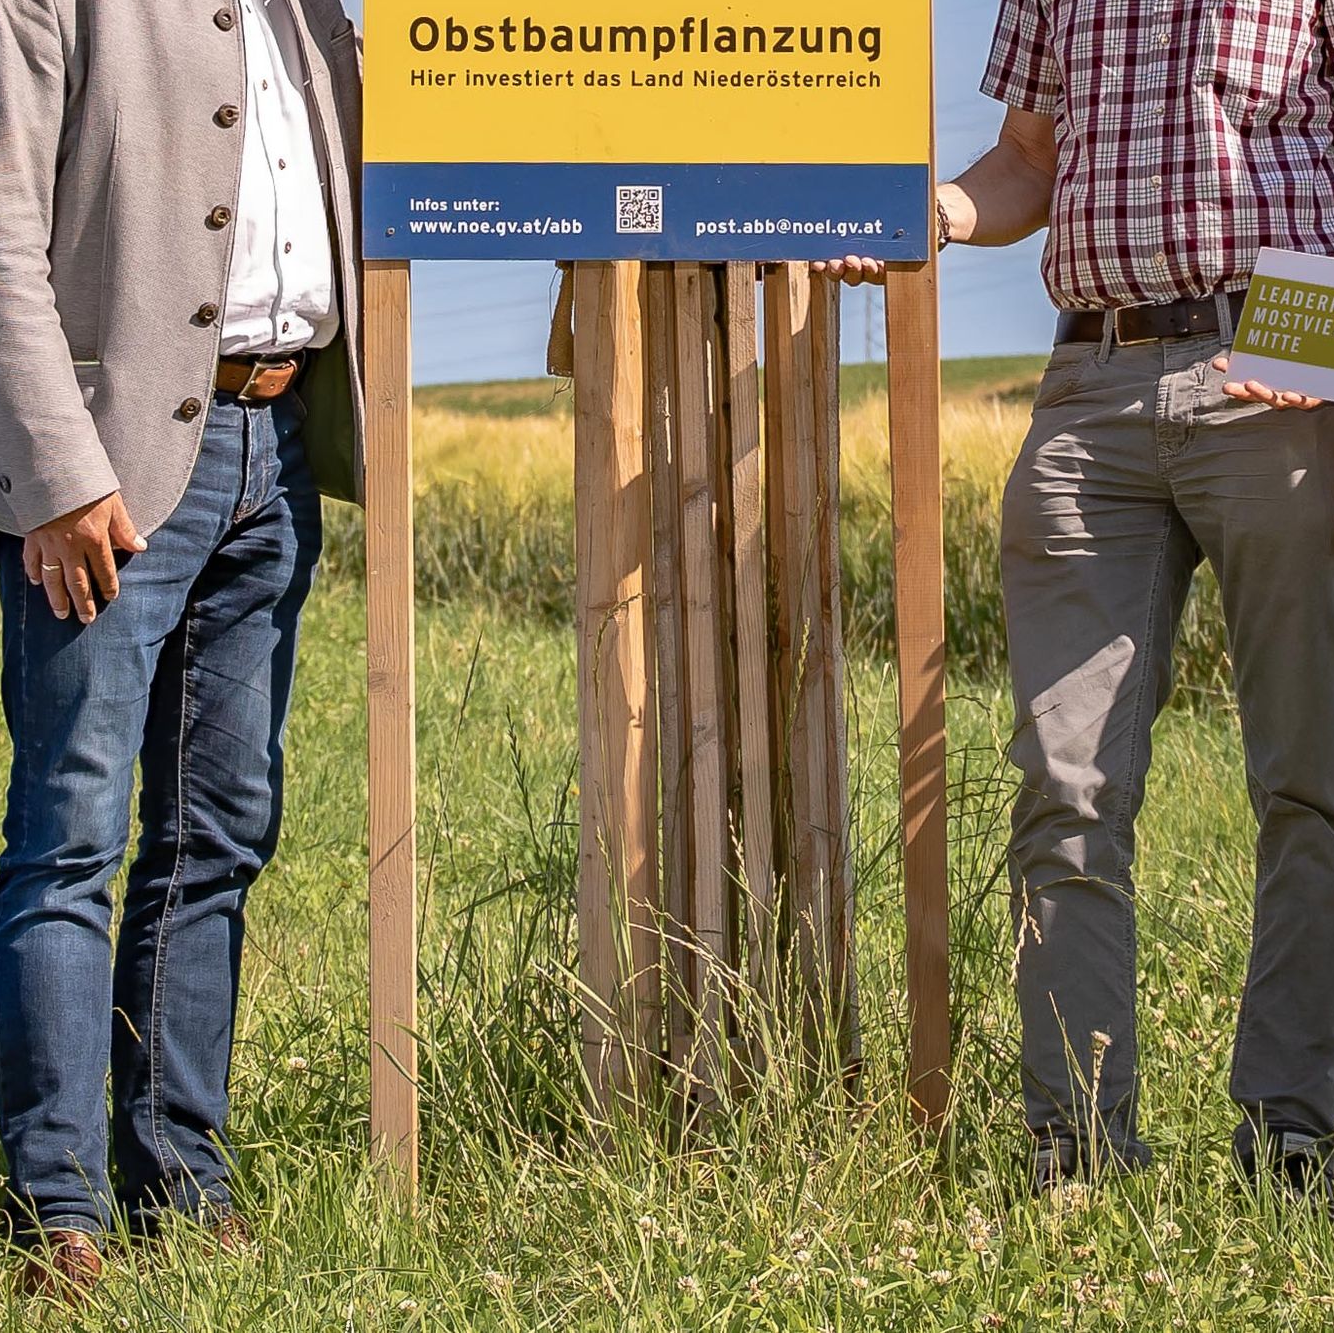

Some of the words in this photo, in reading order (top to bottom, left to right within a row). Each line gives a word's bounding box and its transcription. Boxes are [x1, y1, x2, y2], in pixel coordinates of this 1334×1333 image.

[409, 16, 881, 62] Obstbaumpflanzung
[410, 69, 456, 87] Hier
[466, 69, 574, 87] investiert
[584, 70, 621, 87] das
[631, 70, 683, 87] Land
[693, 70, 881, 87] Niederösterreich
[410, 198, 447, 211] Infos
[453, 199, 500, 211] unter:
[409, 217, 583, 236] www.noe.gv.at/abb
[695, 218, 883, 237] post.abb@noel.gv.at
[1246, 328, 1302, 353] MITTE
